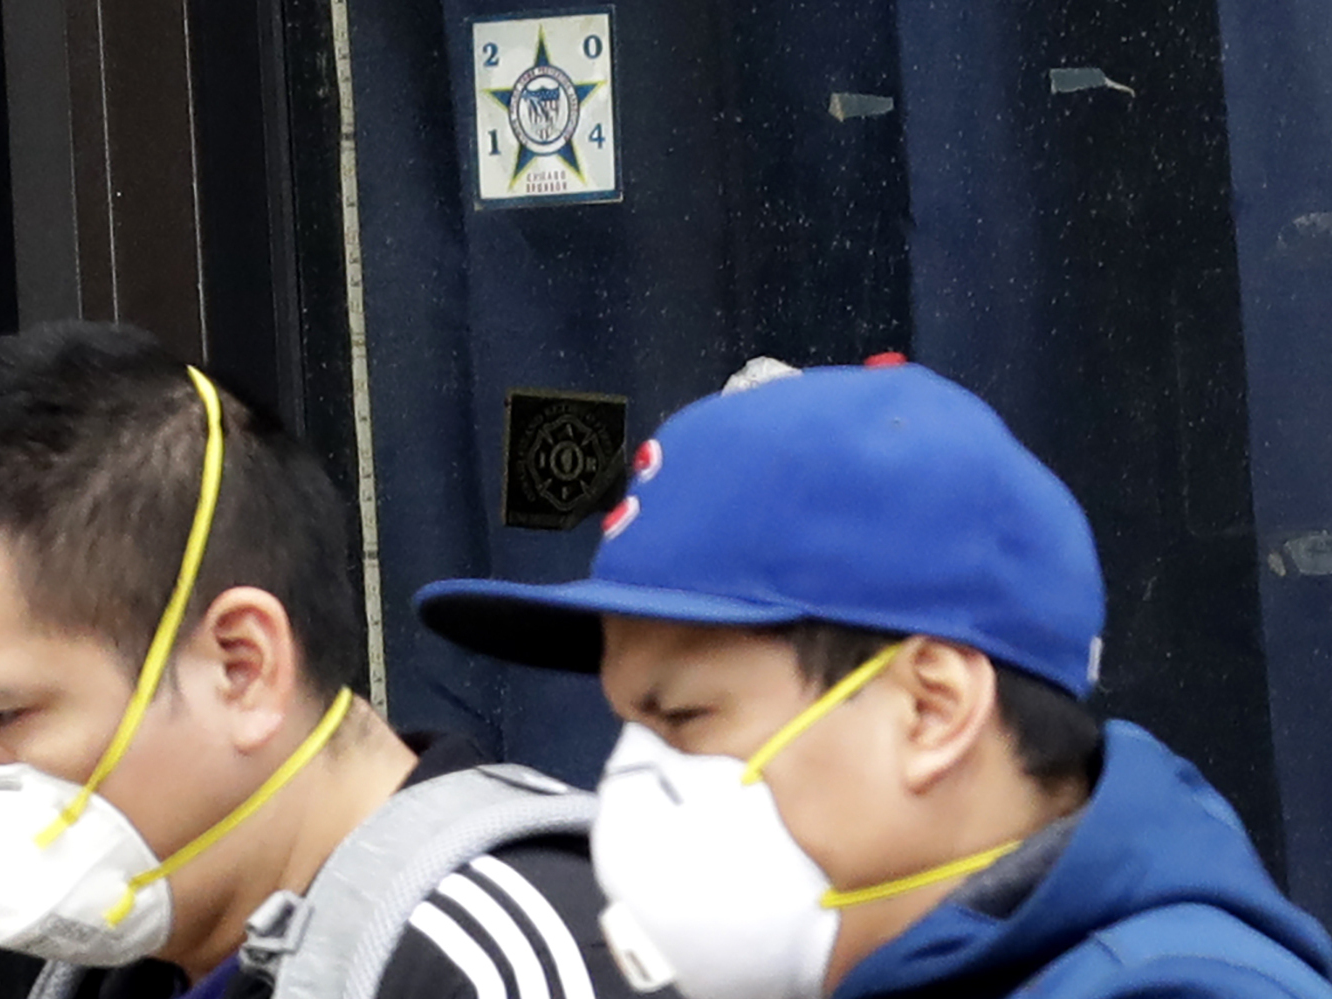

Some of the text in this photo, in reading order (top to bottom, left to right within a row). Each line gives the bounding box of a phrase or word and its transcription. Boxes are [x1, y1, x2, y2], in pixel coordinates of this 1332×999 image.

[482, 34, 604, 67] 2 0
[488, 122, 606, 156] 1 4
